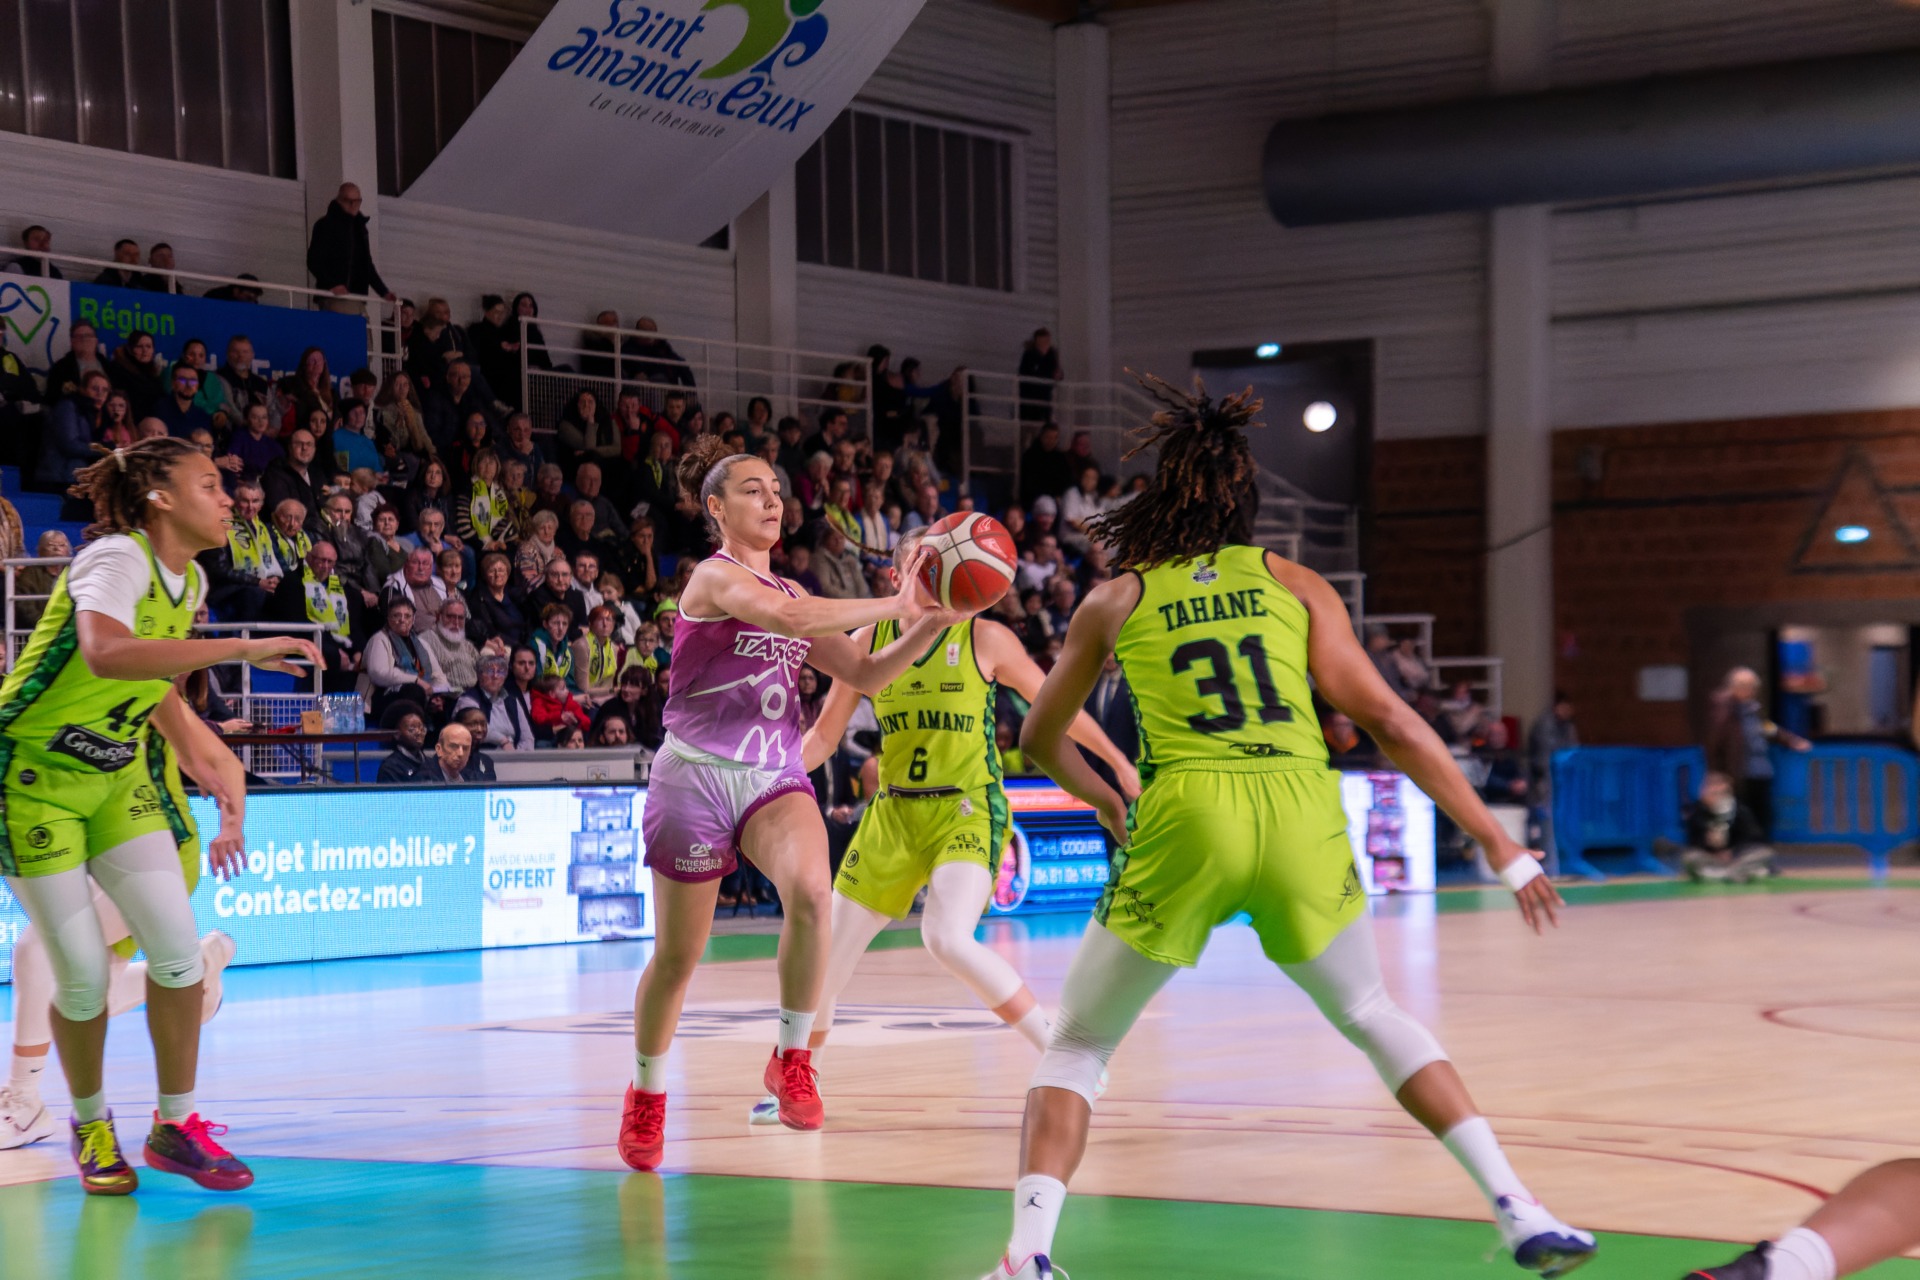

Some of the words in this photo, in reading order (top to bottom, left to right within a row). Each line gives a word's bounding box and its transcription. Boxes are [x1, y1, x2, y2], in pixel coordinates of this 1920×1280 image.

[602, 0, 704, 59] Saint
[615, 100, 653, 121] cité
[652, 109, 726, 139] thermale
[79, 297, 175, 340] Région
[1158, 589, 1268, 632] TAHANE
[1170, 634, 1295, 735] 31
[917, 710, 975, 734] AMAND
[907, 747, 928, 783] 6
[128, 803, 161, 817] SIP
[312, 836, 457, 871] immobilier
[464, 836, 476, 865] ?
[489, 855, 508, 866] AVIS
[510, 854, 521, 865] DE
[523, 852, 555, 864] VALEUR
[214, 875, 423, 918] Contactez-moi
[489, 868, 555, 891] OFFERT
